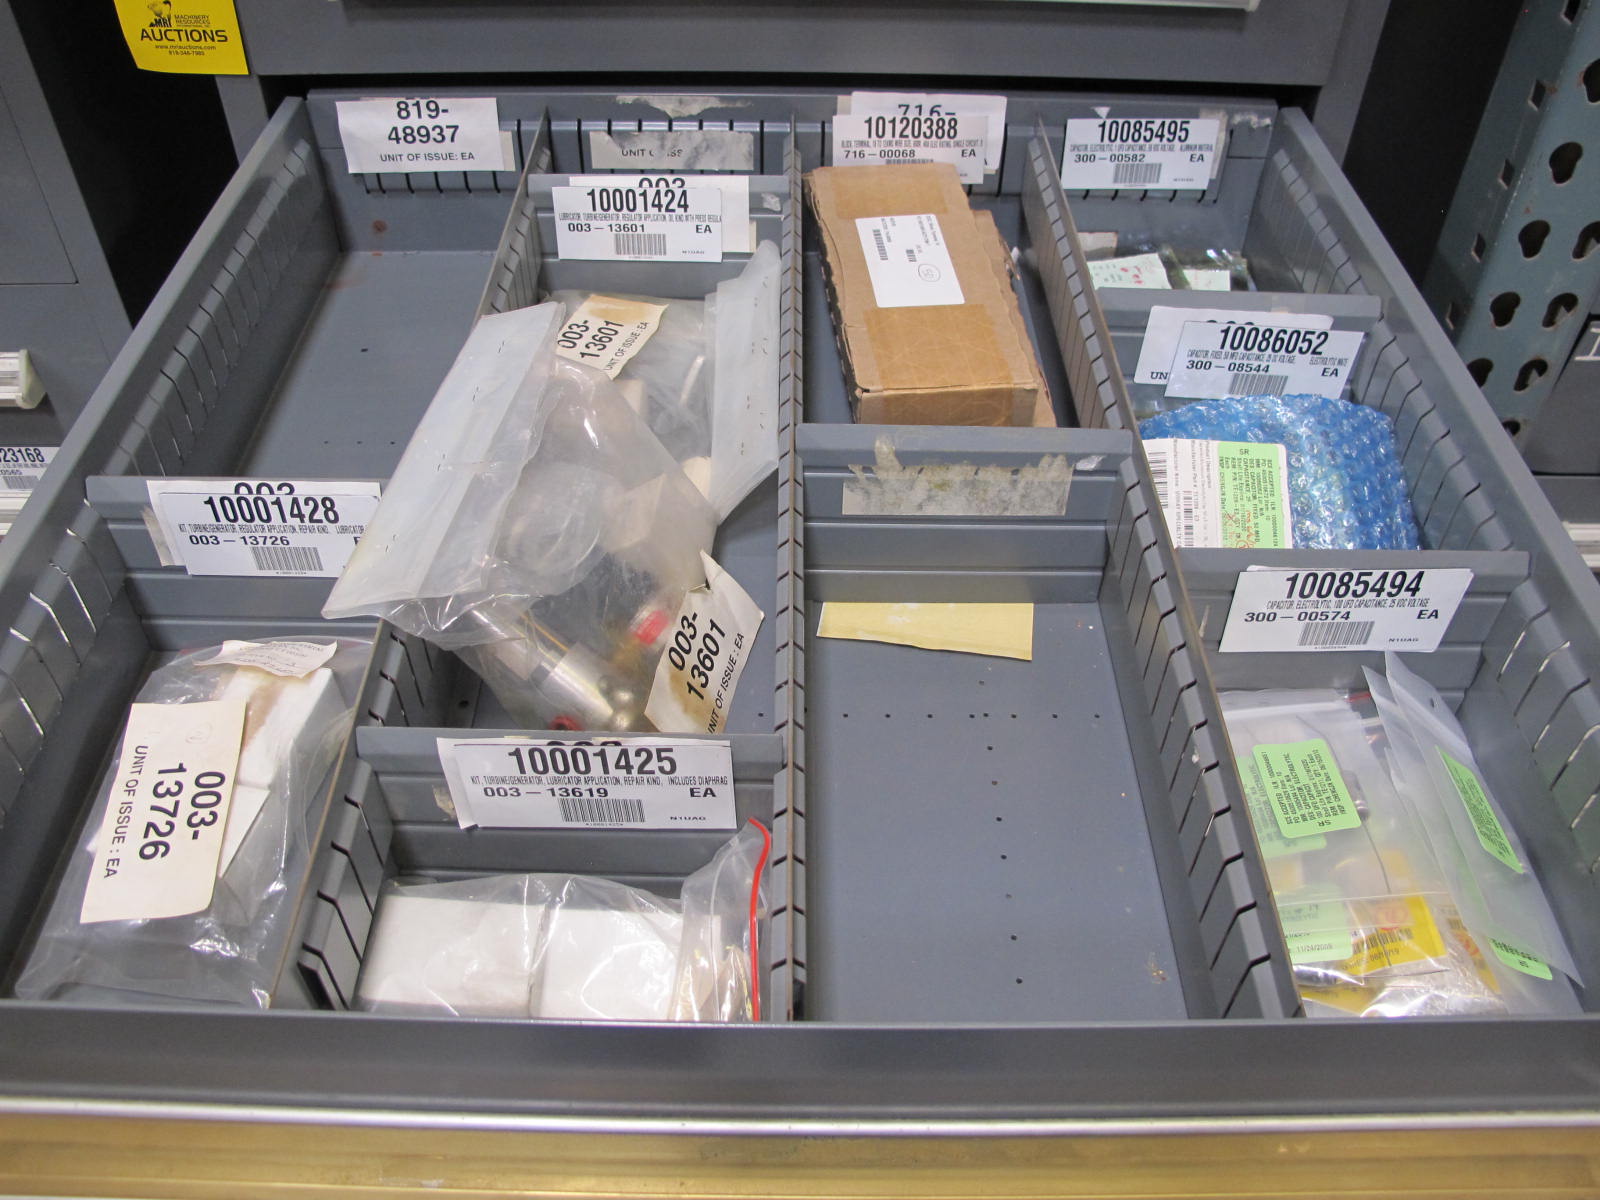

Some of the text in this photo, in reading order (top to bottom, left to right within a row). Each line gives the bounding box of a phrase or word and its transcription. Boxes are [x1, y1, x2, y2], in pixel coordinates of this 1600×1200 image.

[154, 17, 172, 28] MRI
[140, 28, 228, 42] AUCTIONS
[396, 100, 449, 120] 819-
[388, 125, 459, 144] 48937
[864, 116, 958, 139] 10120388
[1098, 120, 1190, 143] 10085495
[380, 152, 475, 162] UNIT OF ISSUE: EA
[621, 149, 646, 157] UNIT
[961, 149, 976, 158] EA
[1190, 154, 1205, 162] EA
[587, 188, 689, 213] 10001424
[695, 224, 712, 234] EA
[557, 320, 590, 349] 003-
[580, 320, 624, 359] 13601
[1220, 325, 1329, 356] 10086052
[603, 358, 617, 371] UNIT
[615, 348, 625, 357] OF
[637, 321, 649, 331] EA
[1150, 371, 1169, 380] UN
[1321, 367, 1339, 377] EA
[0, 448, 45, 462] 23168
[203, 496, 340, 524] 10001428
[1286, 571, 1425, 599] 10085494
[1416, 610, 1439, 620] EA
[668, 612, 698, 671] 003-
[687, 618, 726, 701] 13601
[715, 691, 724, 709] OF
[721, 654, 737, 691] ISSUE
[734, 633, 745, 650] EA
[508, 747, 677, 776] 10001425
[546, 776, 582, 786] LUBRICATOR
[624, 776, 646, 786] REPAIR
[667, 776, 697, 786] INCLUDES
[698, 776, 728, 786] DIAPHRAG
[690, 787, 716, 798] EA
[104, 745, 148, 879] UNIT OF ISSUE EA
[138, 762, 187, 861] 13726
[186, 771, 226, 841] 003-
[1317, 819, 1332, 827] SR
